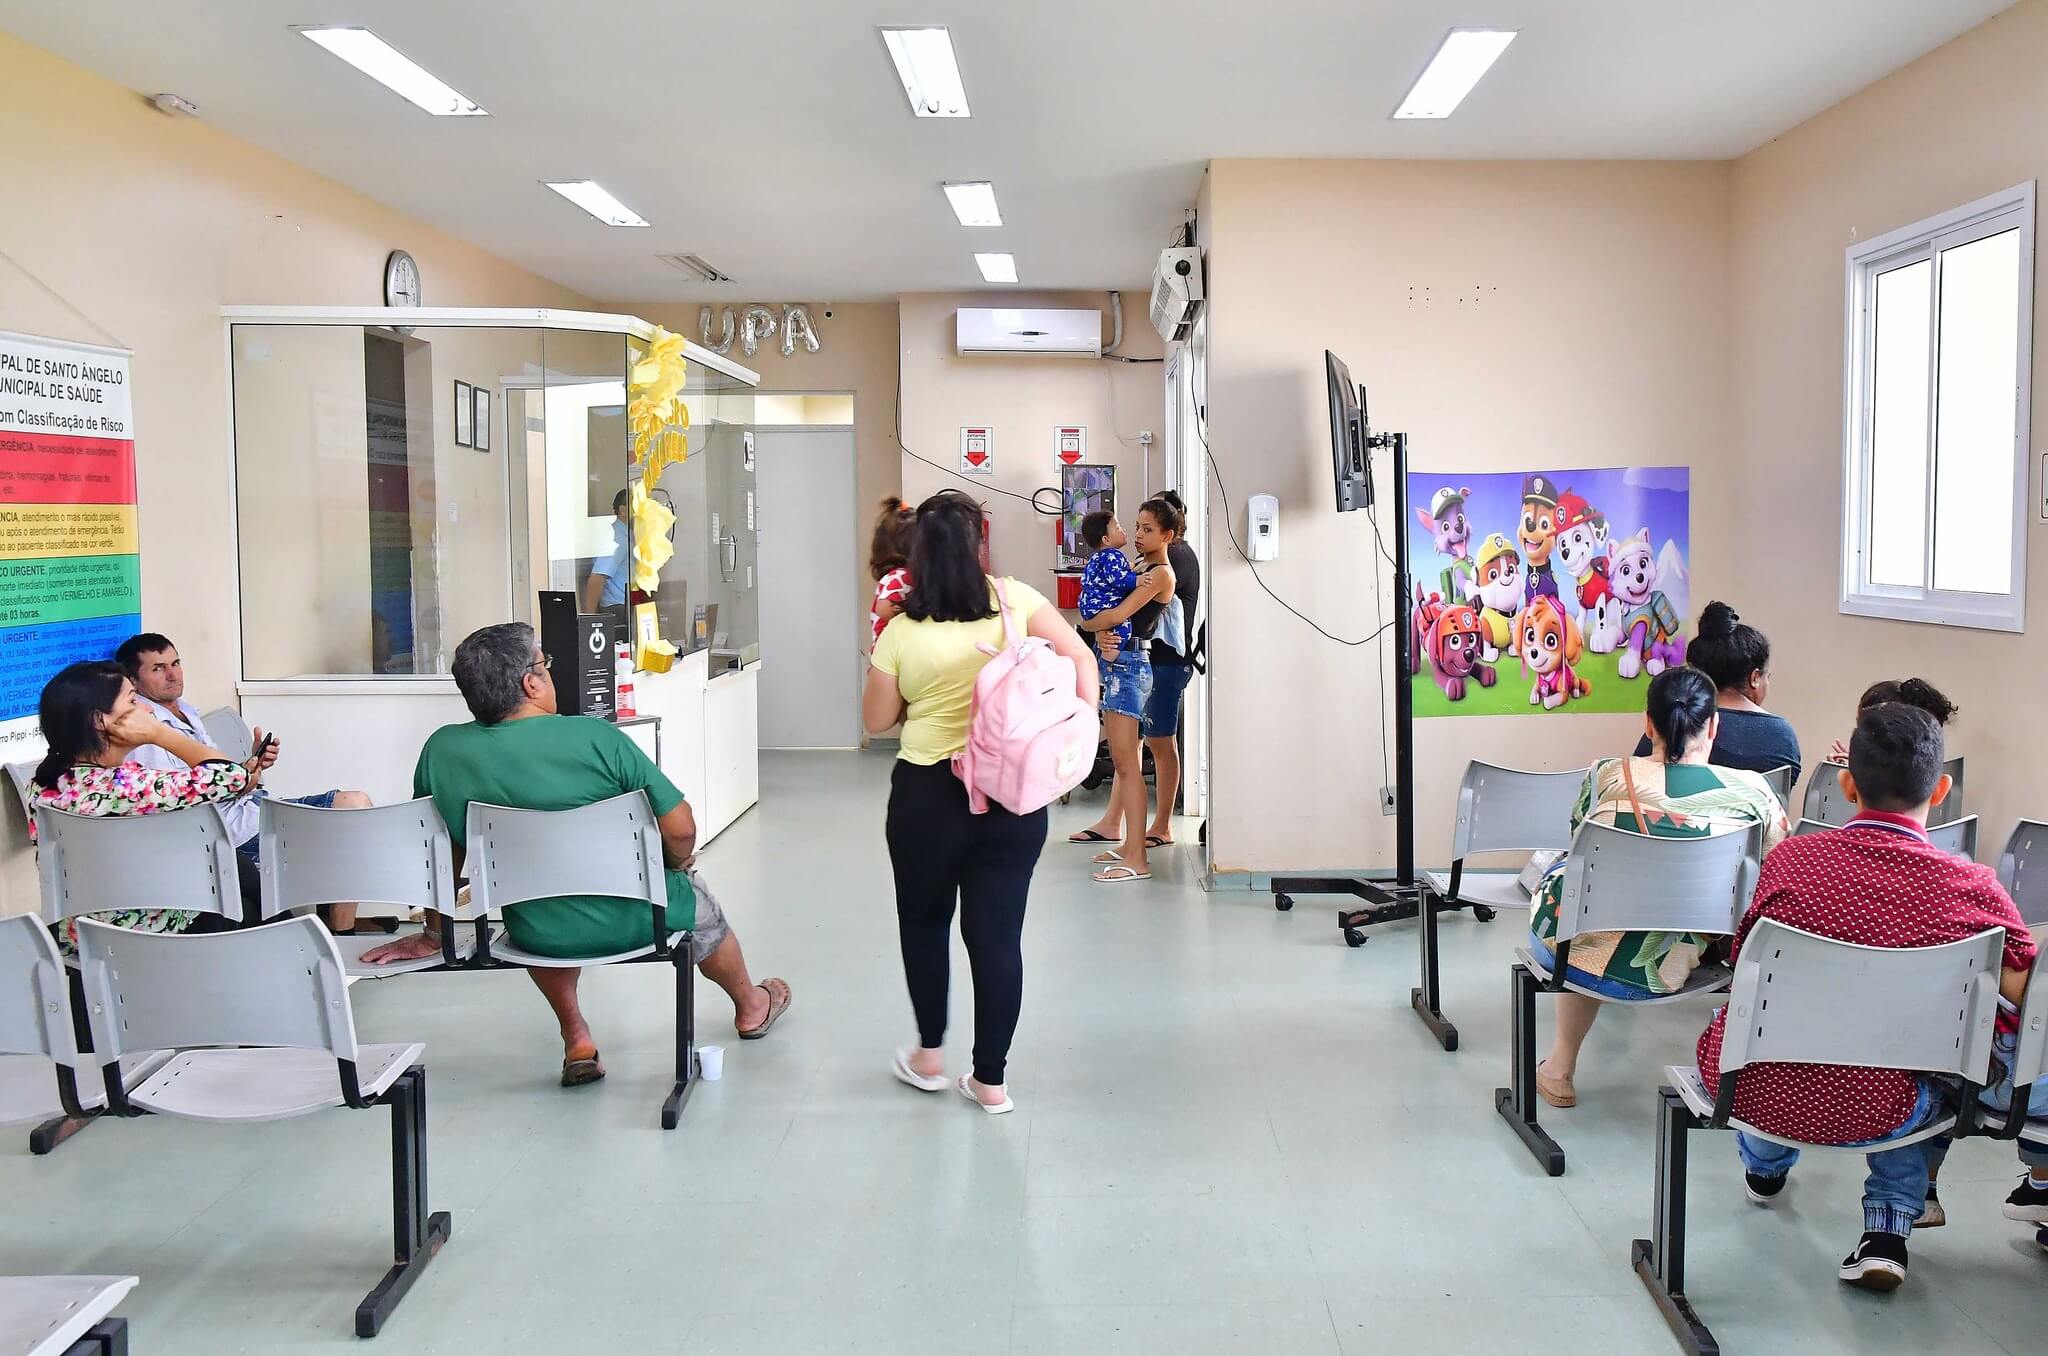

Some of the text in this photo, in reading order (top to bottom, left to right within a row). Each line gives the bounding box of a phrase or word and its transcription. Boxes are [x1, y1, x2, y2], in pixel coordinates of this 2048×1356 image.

[699, 304, 821, 359] UPA
[0, 353, 123, 385] PAL DE SANTO ÂNGELO
[50, 383, 64, 399] DE
[67, 384, 103, 404] SAÚDE
[0, 409, 124, 433] om Classificação de Risco
[0, 511, 20, 523] NCIA,
[21, 512, 60, 522] atendimento
[61, 514, 66, 522] o
[67, 513, 81, 522] mais
[29, 525, 68, 537] atendimento
[60, 588, 95, 601] VERMELHO
[9, 609, 18, 621] 03
[20, 608, 41, 619] horas.
[0, 660, 31, 673] ndimento
[10, 729, 27, 743] Pippi
